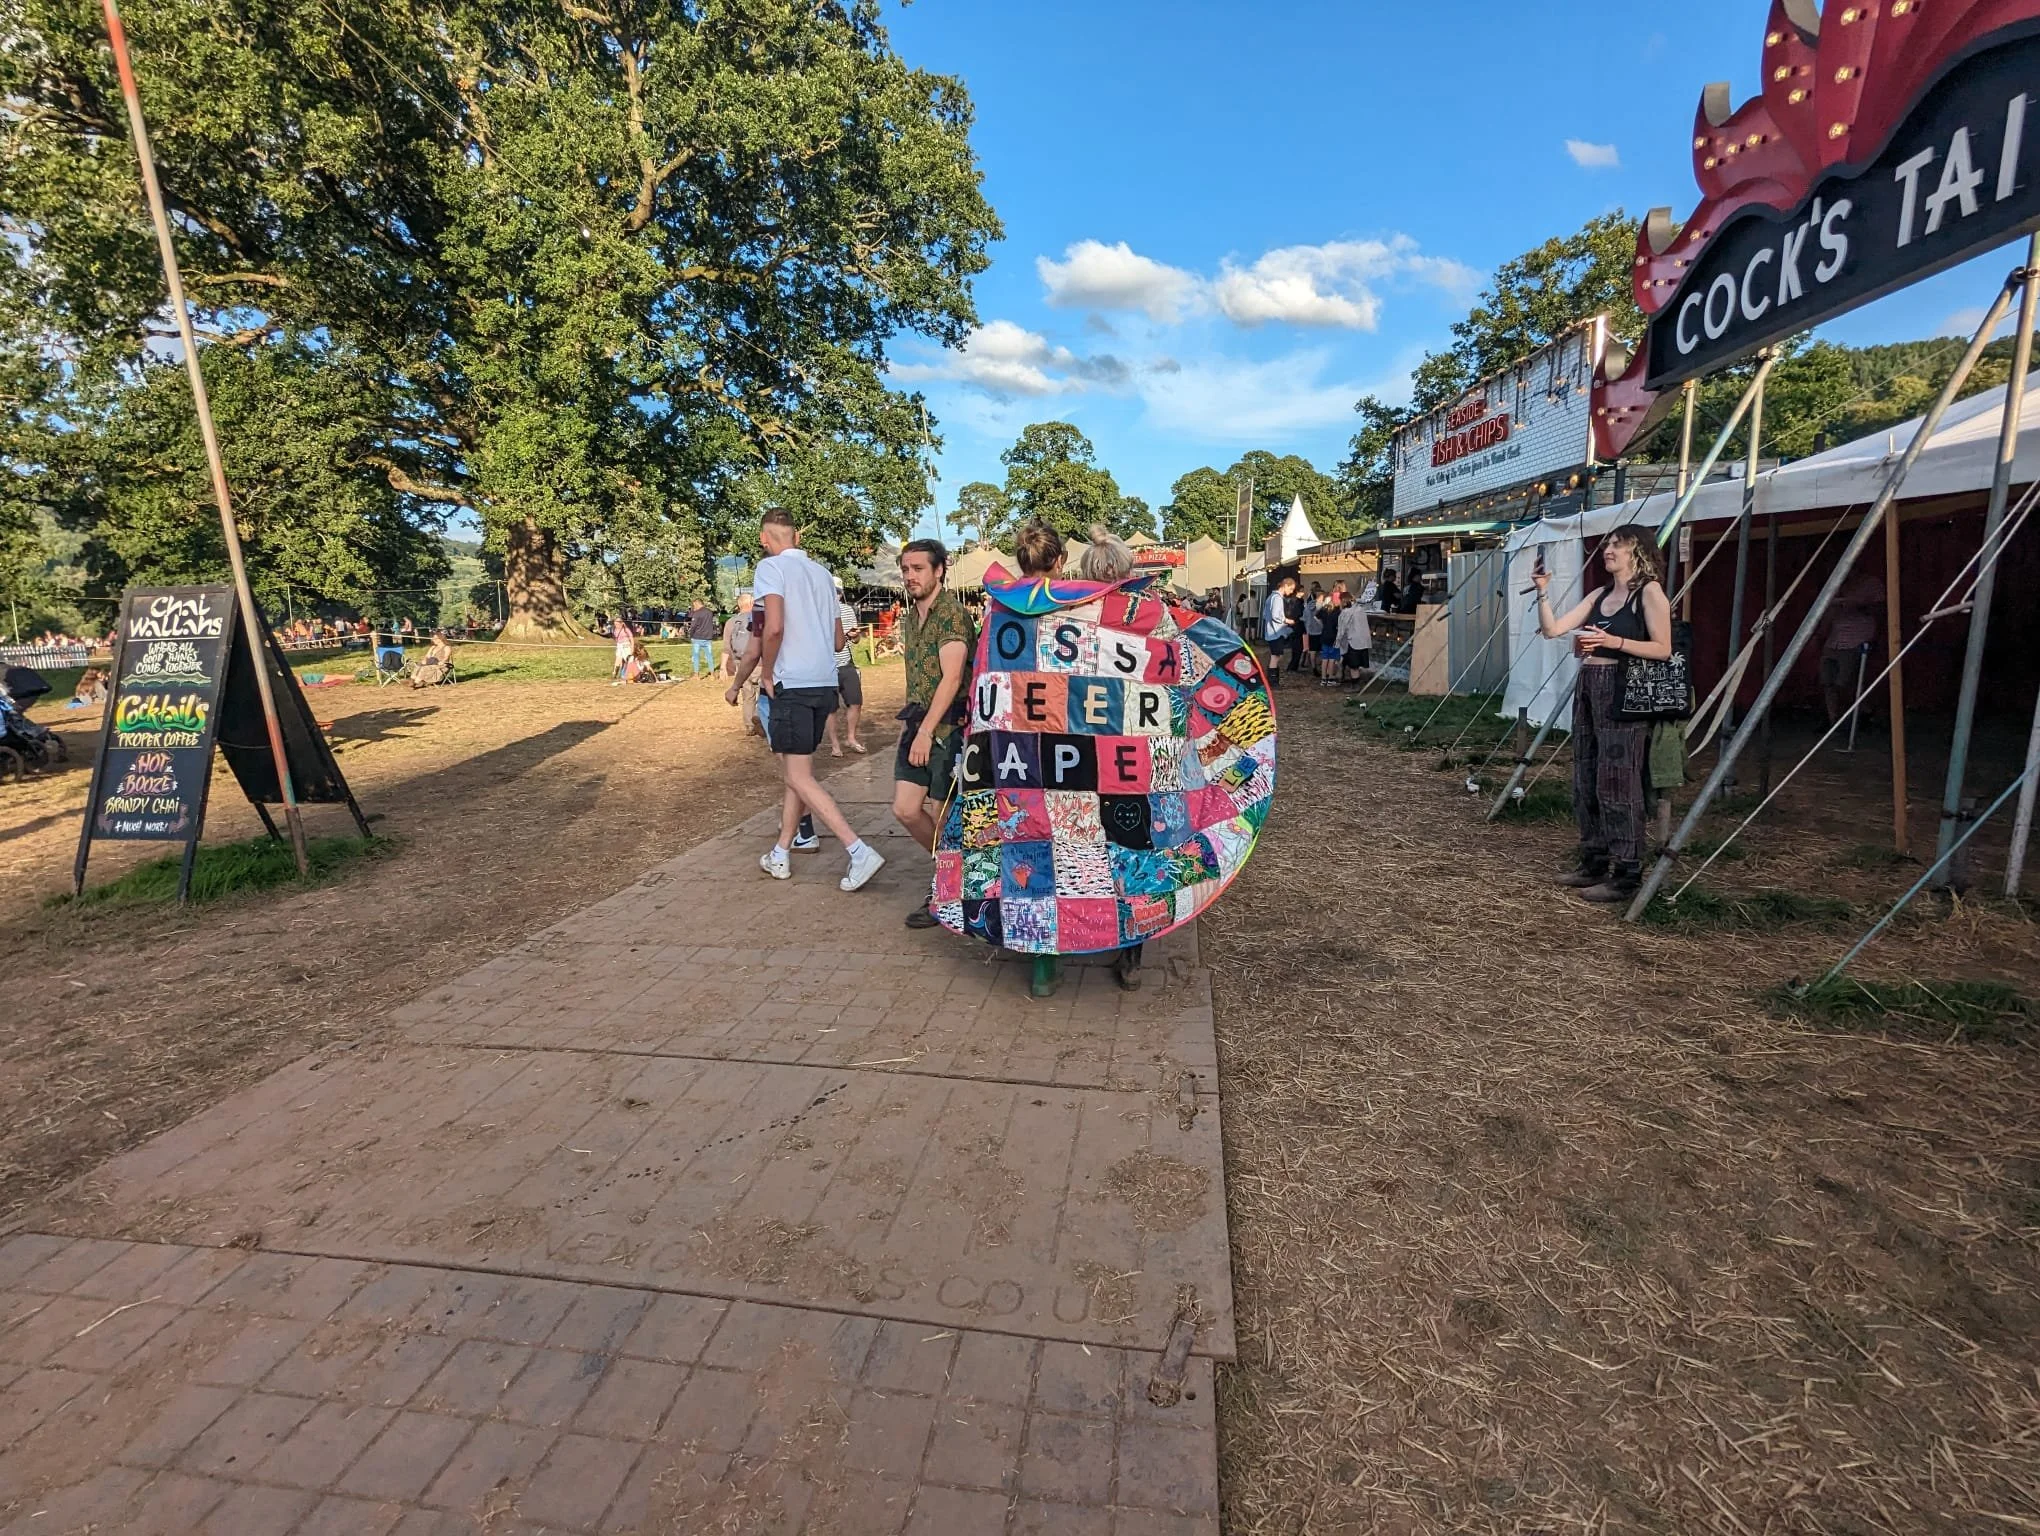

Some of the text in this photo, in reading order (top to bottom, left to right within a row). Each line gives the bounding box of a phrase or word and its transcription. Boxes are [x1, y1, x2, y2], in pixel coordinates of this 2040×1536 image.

[1675, 197, 1853, 356] COCK'S
[1447, 403, 1479, 430] SEASIDE
[1431, 440, 1453, 465] FISH
[1456, 433, 1463, 456] &
[1467, 415, 1504, 451] CHIPS
[1148, 553, 1167, 561] PIZZA
[150, 593, 211, 618] Chai
[142, 650, 199, 664] GOOD THINGS
[148, 641, 178, 655] WHERE
[135, 660, 204, 675] COME TOGETHER
[115, 693, 210, 733] Cocktails
[973, 681, 1160, 729] UEER
[117, 731, 201, 748] PROPER COFFEE
[137, 752, 172, 774] HOT
[962, 741, 1138, 783] CAPE
[124, 774, 171, 796] BOOZE
[104, 796, 150, 816] BRANDY
